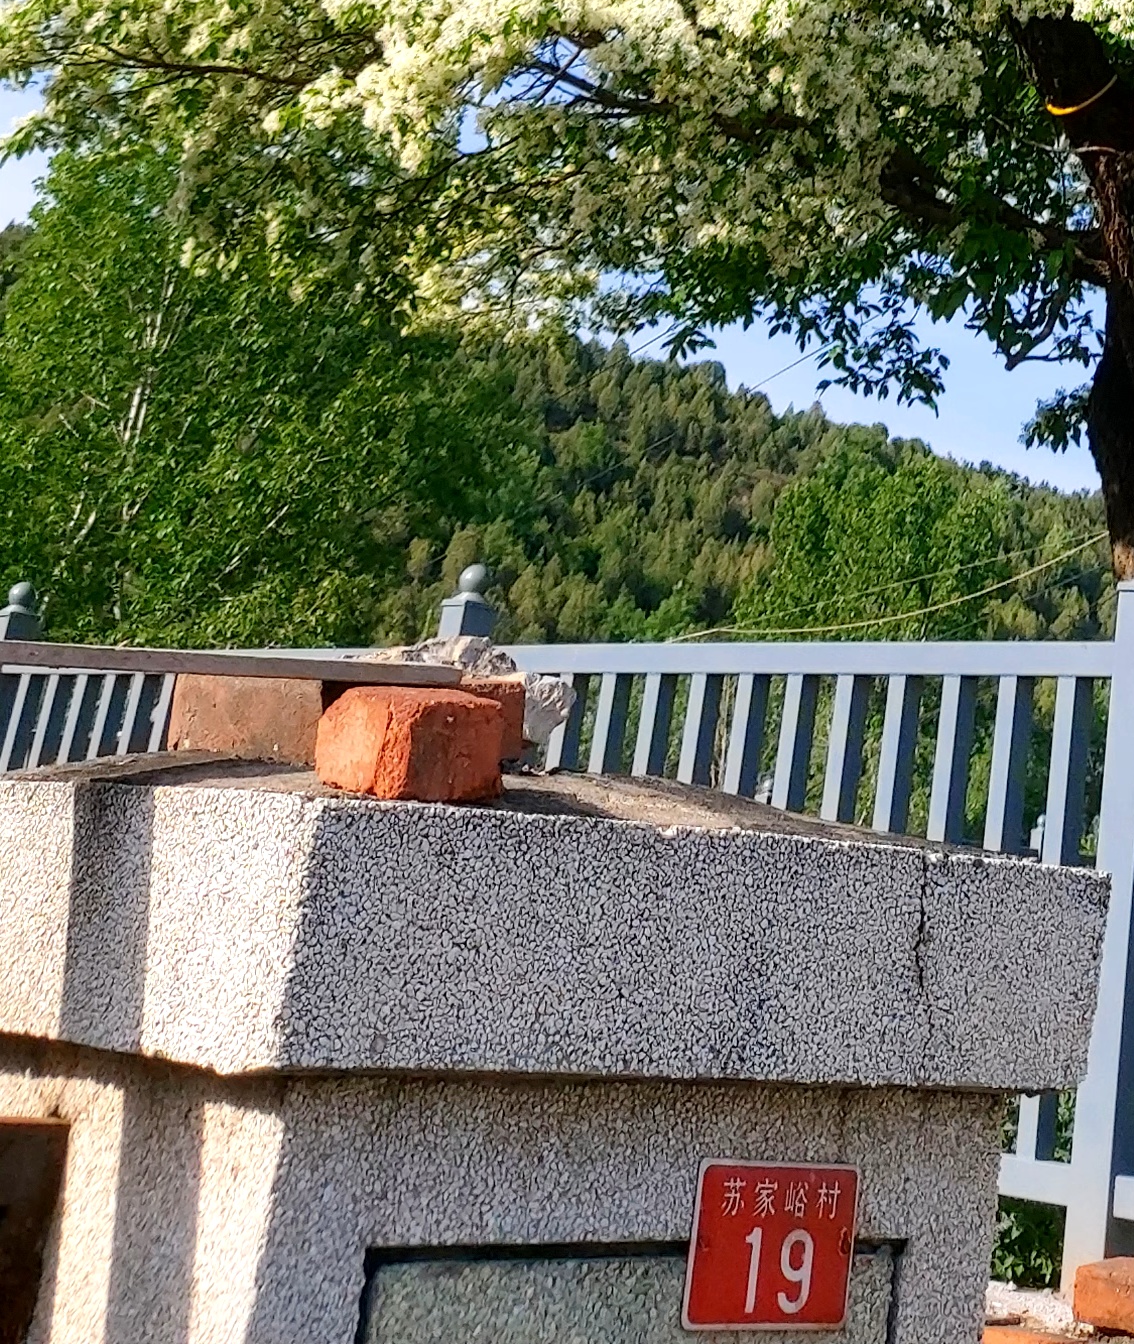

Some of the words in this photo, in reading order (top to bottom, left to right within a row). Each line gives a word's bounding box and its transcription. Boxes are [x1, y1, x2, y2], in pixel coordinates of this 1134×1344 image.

[721, 1177, 841, 1220] 苏家峪村
[744, 1226, 814, 1314] 19
